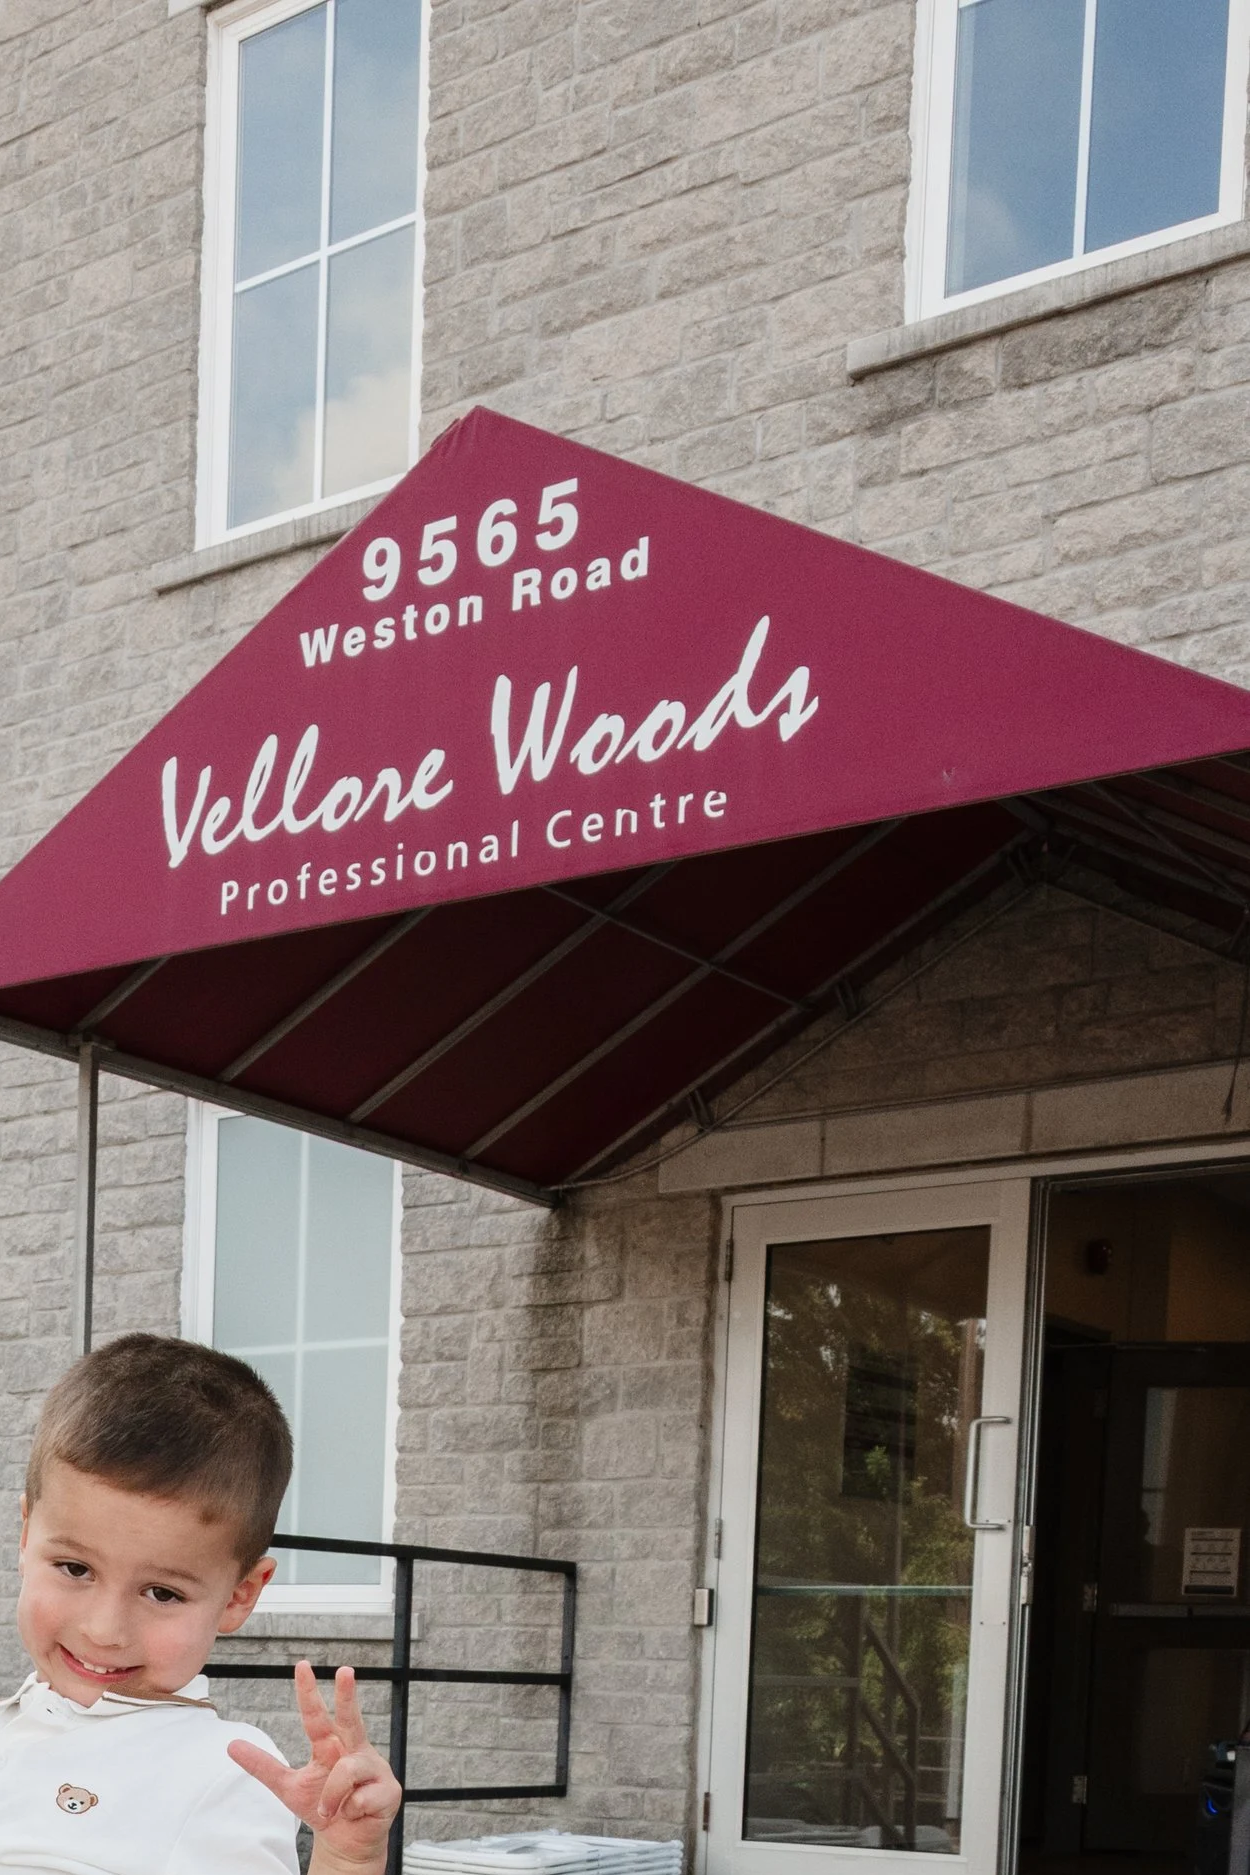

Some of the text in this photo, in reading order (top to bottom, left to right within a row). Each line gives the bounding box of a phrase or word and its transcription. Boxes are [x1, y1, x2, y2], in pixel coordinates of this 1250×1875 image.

[299, 536, 651, 669] Weston Road
[361, 477, 580, 602] 9565
[161, 614, 819, 869] Vellore Woods
[220, 789, 727, 915] Professional Centre
